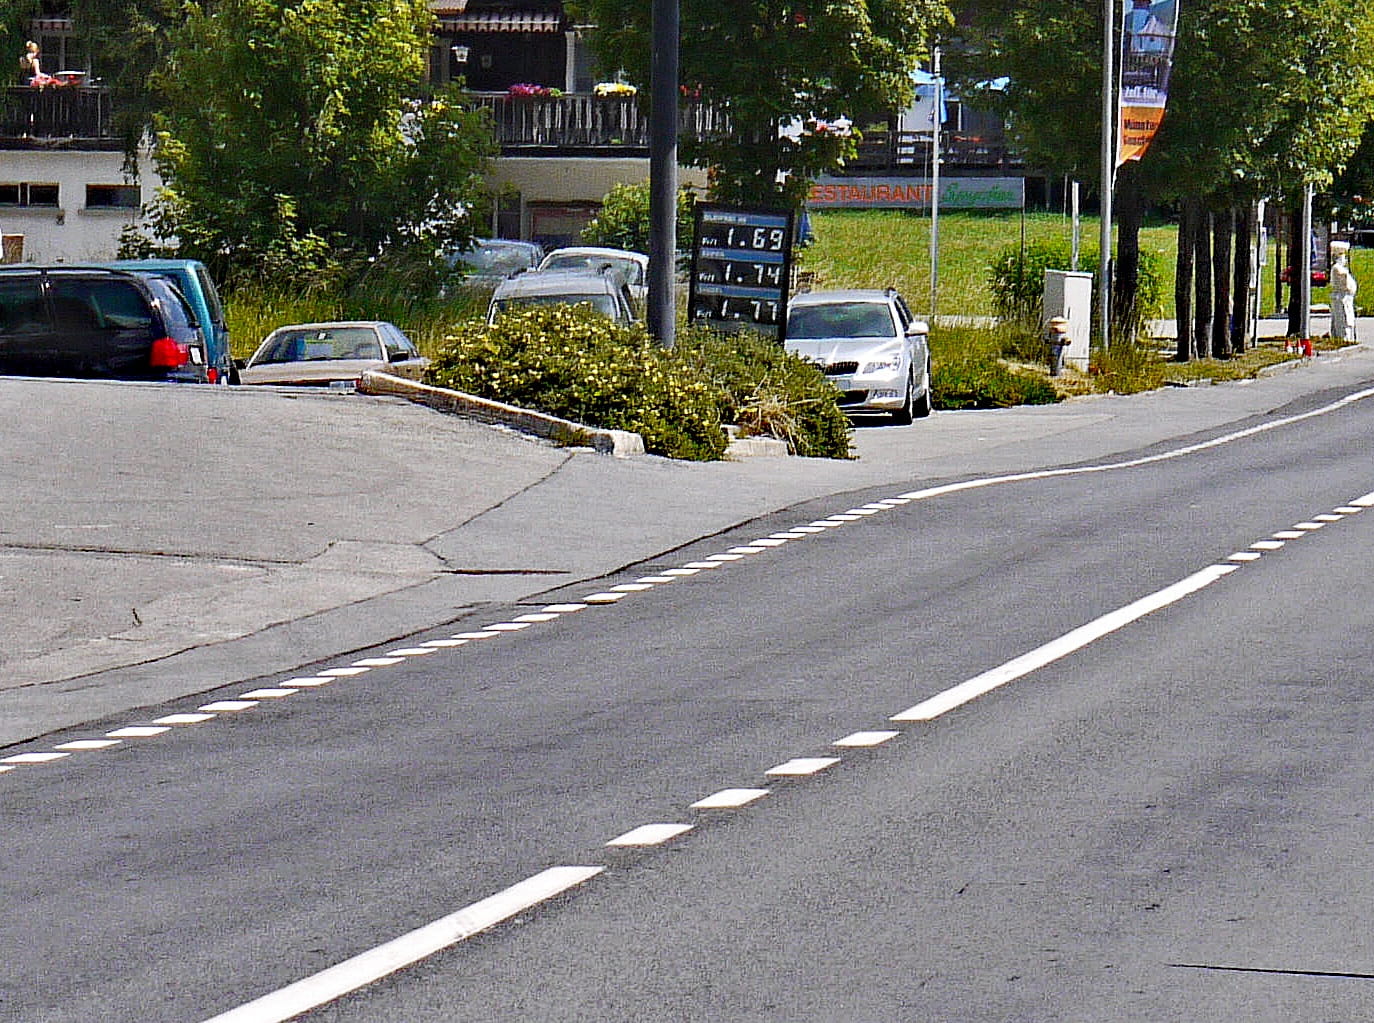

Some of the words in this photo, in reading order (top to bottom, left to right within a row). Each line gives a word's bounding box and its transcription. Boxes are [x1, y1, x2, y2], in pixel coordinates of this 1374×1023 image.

[808, 183, 934, 203] ESTAURANT
[728, 227, 783, 251] 1.69
[725, 263, 780, 285] 1.74
[721, 299, 778, 321] 1.77
